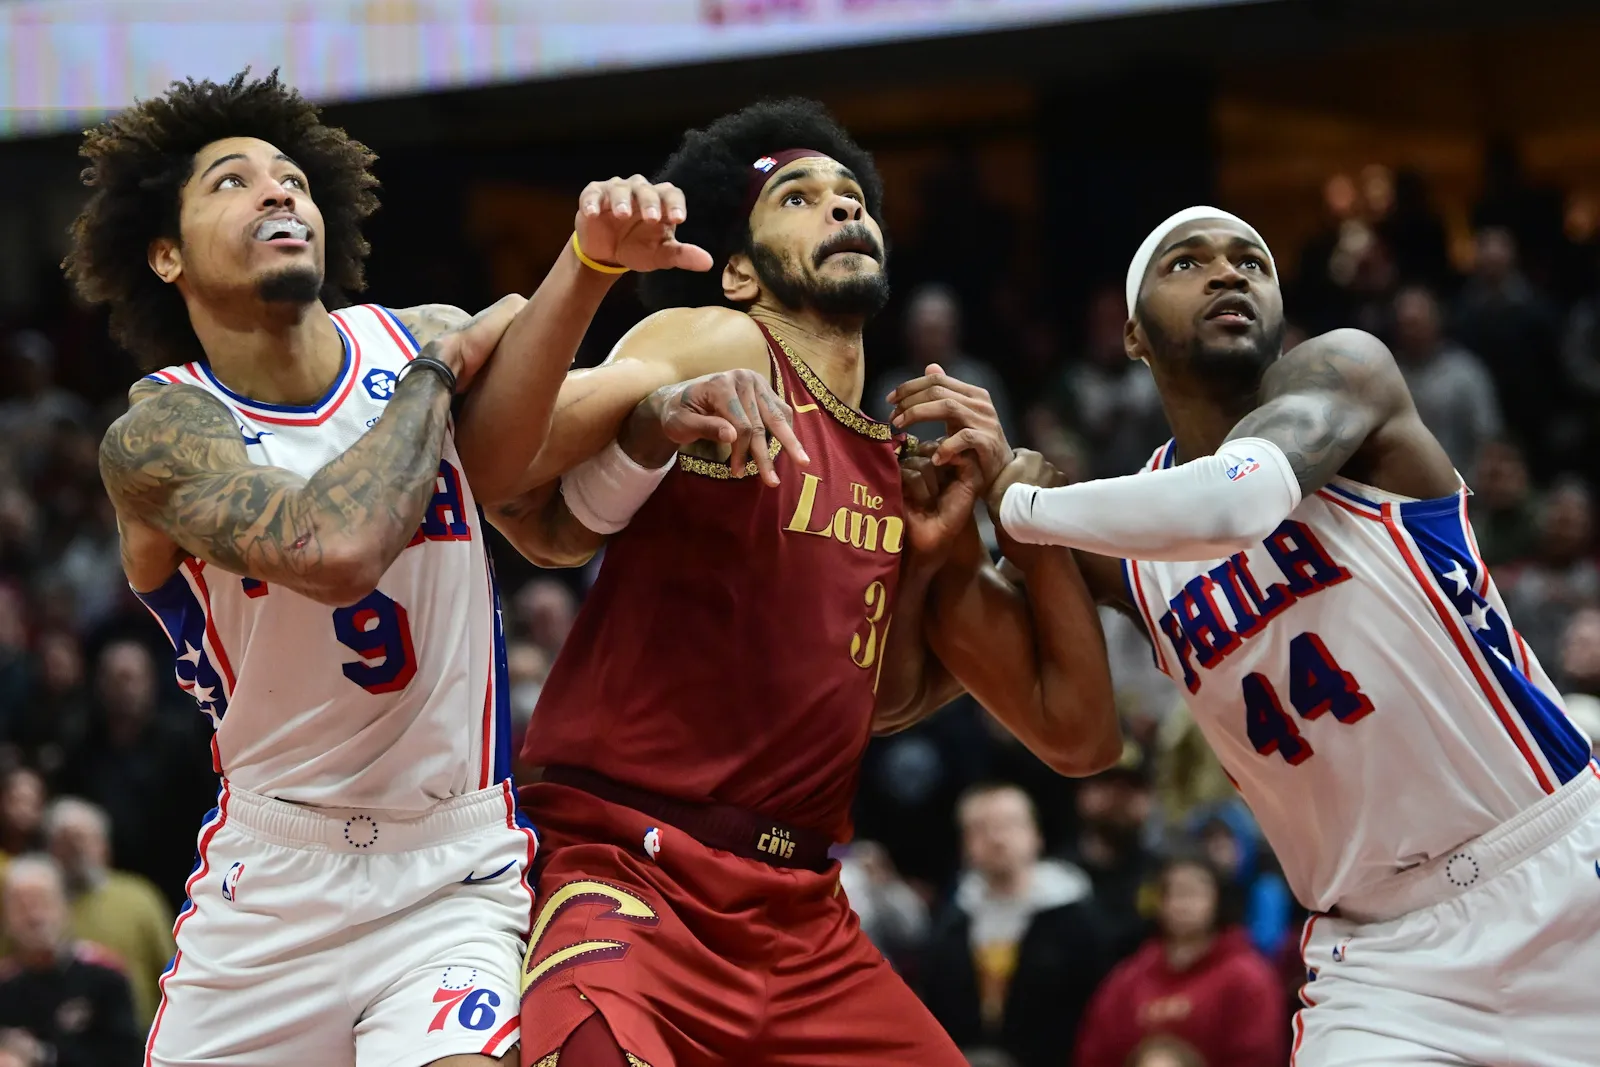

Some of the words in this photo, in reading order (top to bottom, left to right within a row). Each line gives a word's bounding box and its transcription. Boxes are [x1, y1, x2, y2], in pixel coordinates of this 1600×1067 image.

[850, 482, 884, 510] The
[332, 588, 418, 695] 9
[1159, 519, 1353, 695] PHILA
[1242, 631, 1376, 767] 44
[756, 833, 796, 859] CAVS
[427, 985, 501, 1035] 76
